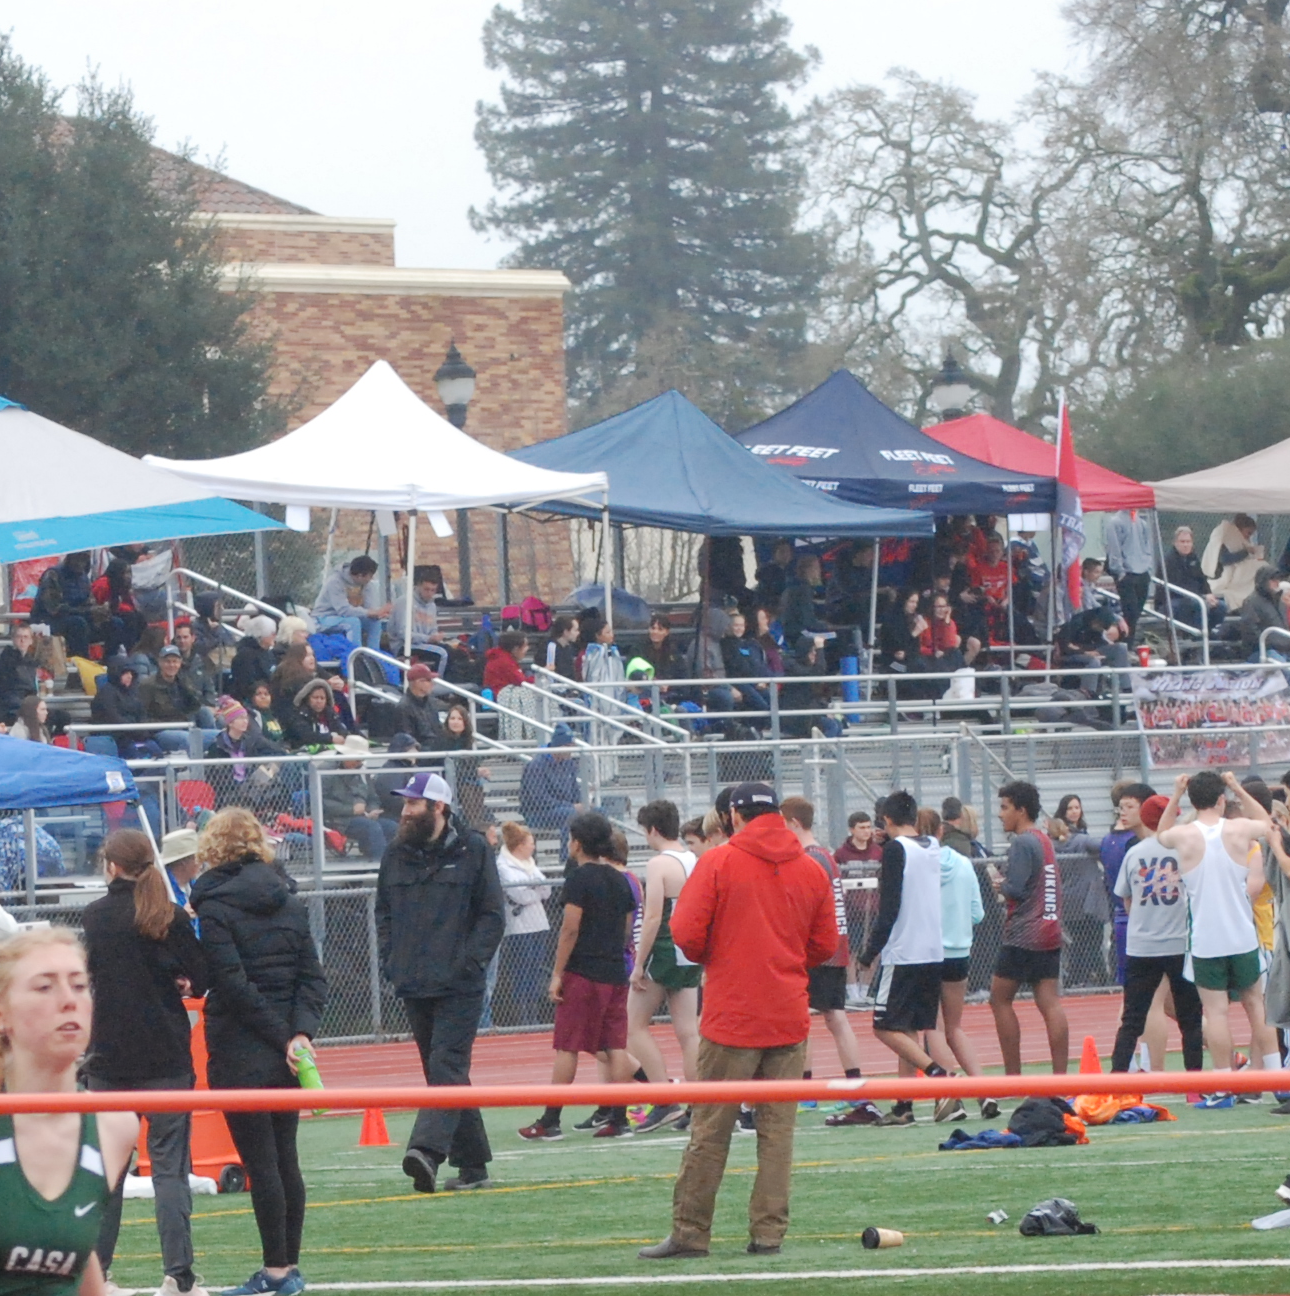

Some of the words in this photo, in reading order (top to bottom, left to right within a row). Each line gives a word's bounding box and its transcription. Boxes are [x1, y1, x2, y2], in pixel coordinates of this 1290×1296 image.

[785, 445, 841, 459] FEET
[878, 449, 923, 462] FLEET
[831, 877, 848, 936] VIKINGS
[1042, 863, 1059, 921] VIKINGS
